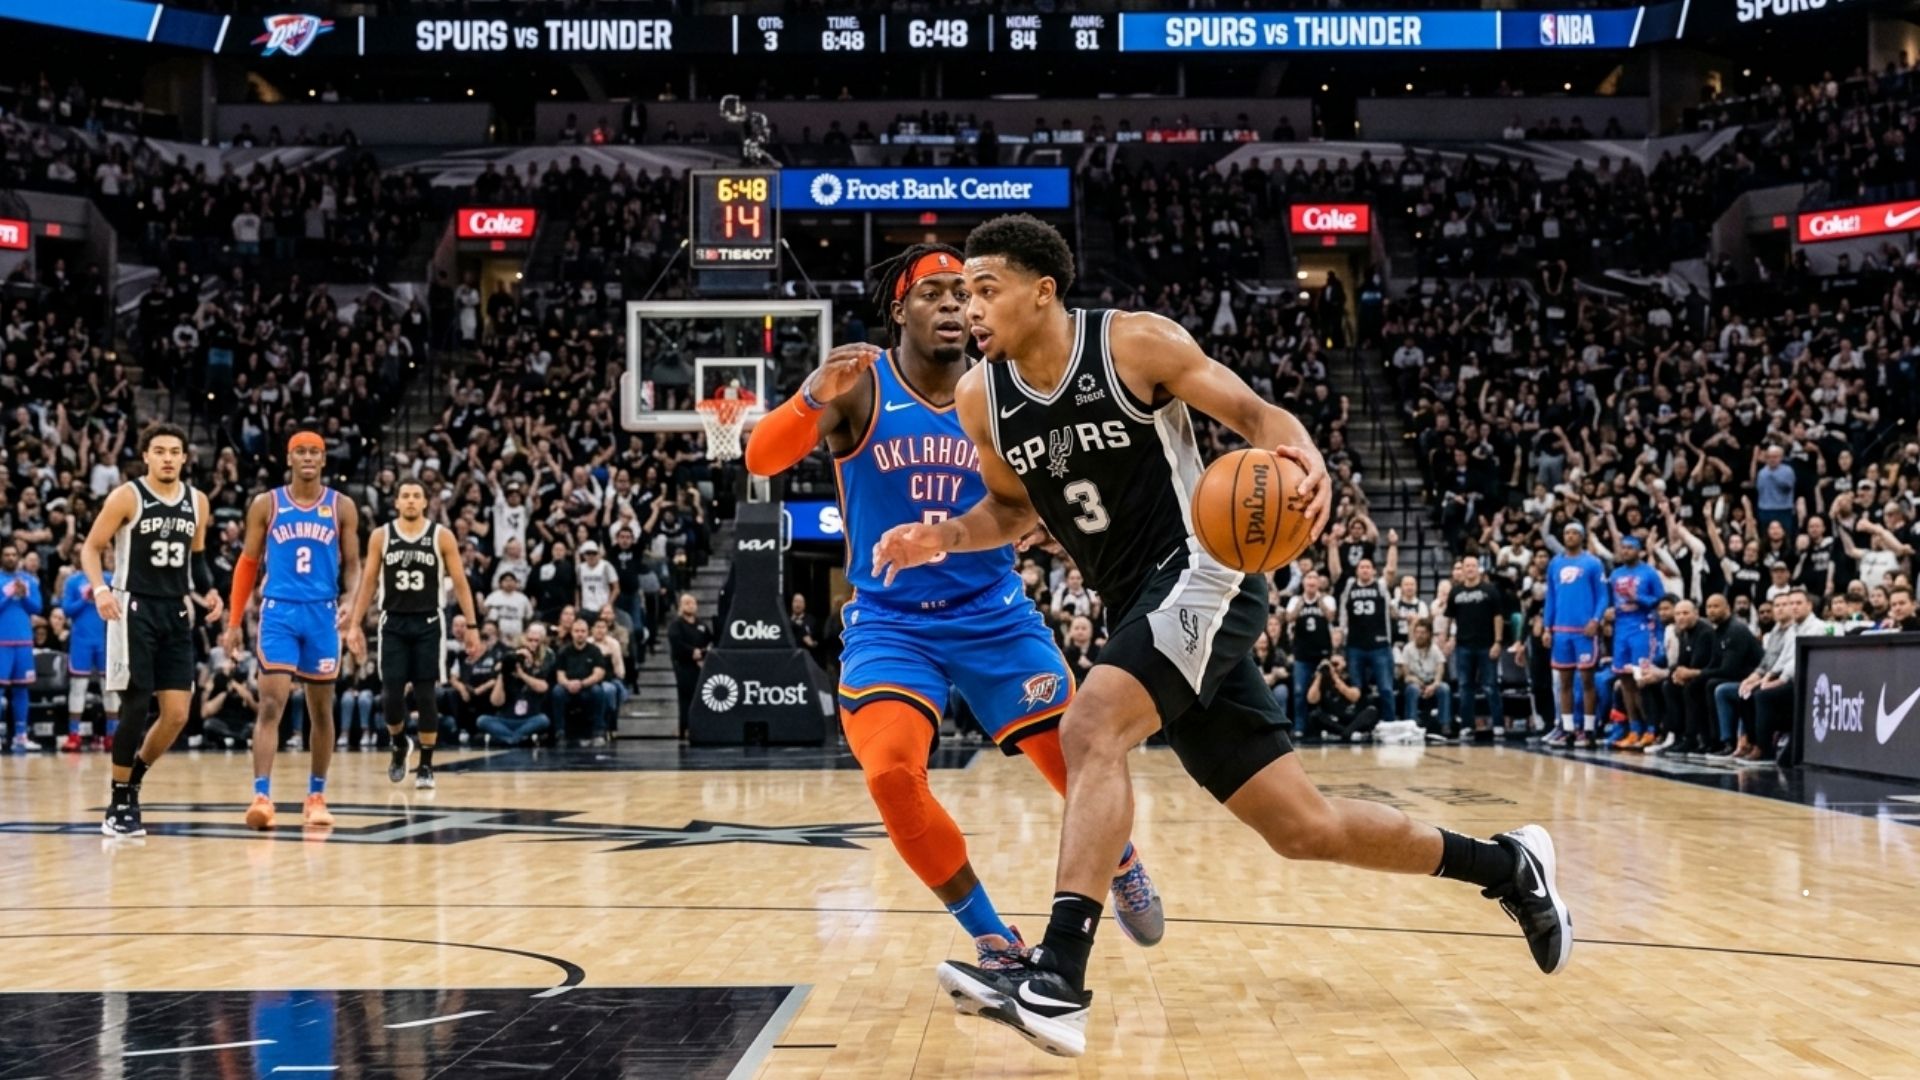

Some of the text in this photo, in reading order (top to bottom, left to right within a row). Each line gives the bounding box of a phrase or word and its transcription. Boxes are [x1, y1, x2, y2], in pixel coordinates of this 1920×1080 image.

[416, 20, 508, 51] SPURS
[544, 20, 673, 51] THUNDER
[763, 31, 779, 51] 3
[908, 19, 969, 48] 6:48
[1009, 29, 1038, 51] 84
[1075, 29, 1100, 51] 81
[1165, 17, 1257, 47] SPURS
[1294, 16, 1422, 46] THUNDER
[1556, 14, 1596, 46] NBA
[718, 178, 768, 202] 6:48
[846, 177, 1033, 200] Frost Bank Center
[725, 205, 761, 239] 14
[910, 472, 964, 503] CITY
[1063, 478, 1111, 534] 3
[150, 540, 185, 568] 33
[295, 546, 312, 574] 2
[395, 569, 425, 591] 33
[1353, 600, 1376, 615] 33
[730, 619, 782, 640] Coke
[742, 680, 808, 705] Frost
